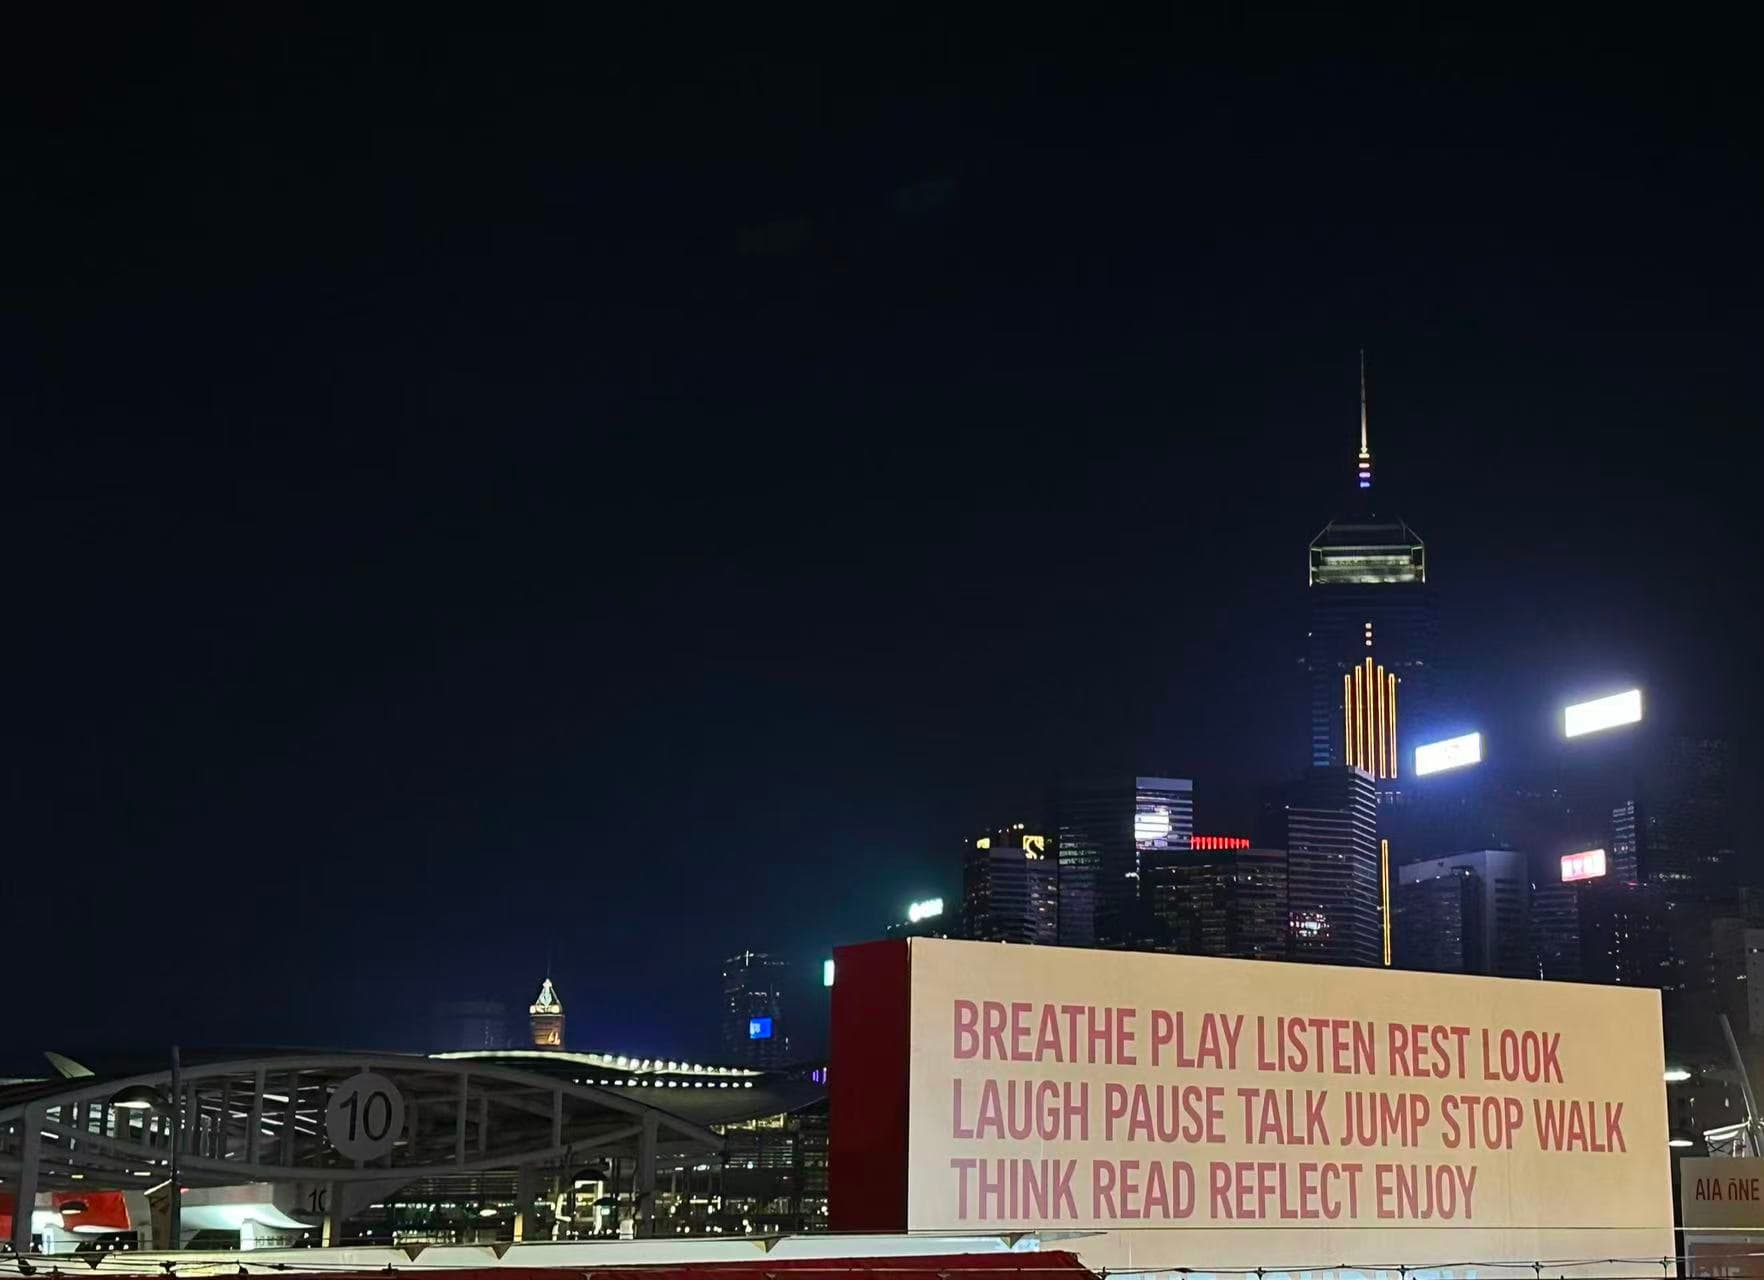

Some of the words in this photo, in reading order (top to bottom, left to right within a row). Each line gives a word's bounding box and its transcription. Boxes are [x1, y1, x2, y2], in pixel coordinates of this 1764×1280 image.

[954, 1000, 1137, 1065] BREATHE
[1151, 1010, 1244, 1070] PLAY
[1257, 1016, 1376, 1076] LISTEN
[1388, 1023, 1470, 1080] REST
[1482, 1028, 1564, 1084] LOOK
[340, 1090, 392, 1141] 10
[953, 1079, 1088, 1141] LAUGH
[1105, 1083, 1226, 1144] PAUSE
[1237, 1088, 1330, 1146] TALK
[1340, 1092, 1430, 1147] JUMP
[1441, 1095, 1524, 1150] STOP
[1533, 1099, 1627, 1153] WALK
[950, 1158, 1079, 1220] THINK
[1093, 1160, 1195, 1220] READ
[1210, 1162, 1363, 1220] REFLECT
[1375, 1164, 1477, 1220] ENJOY
[1696, 1178, 1722, 1201] AIA
